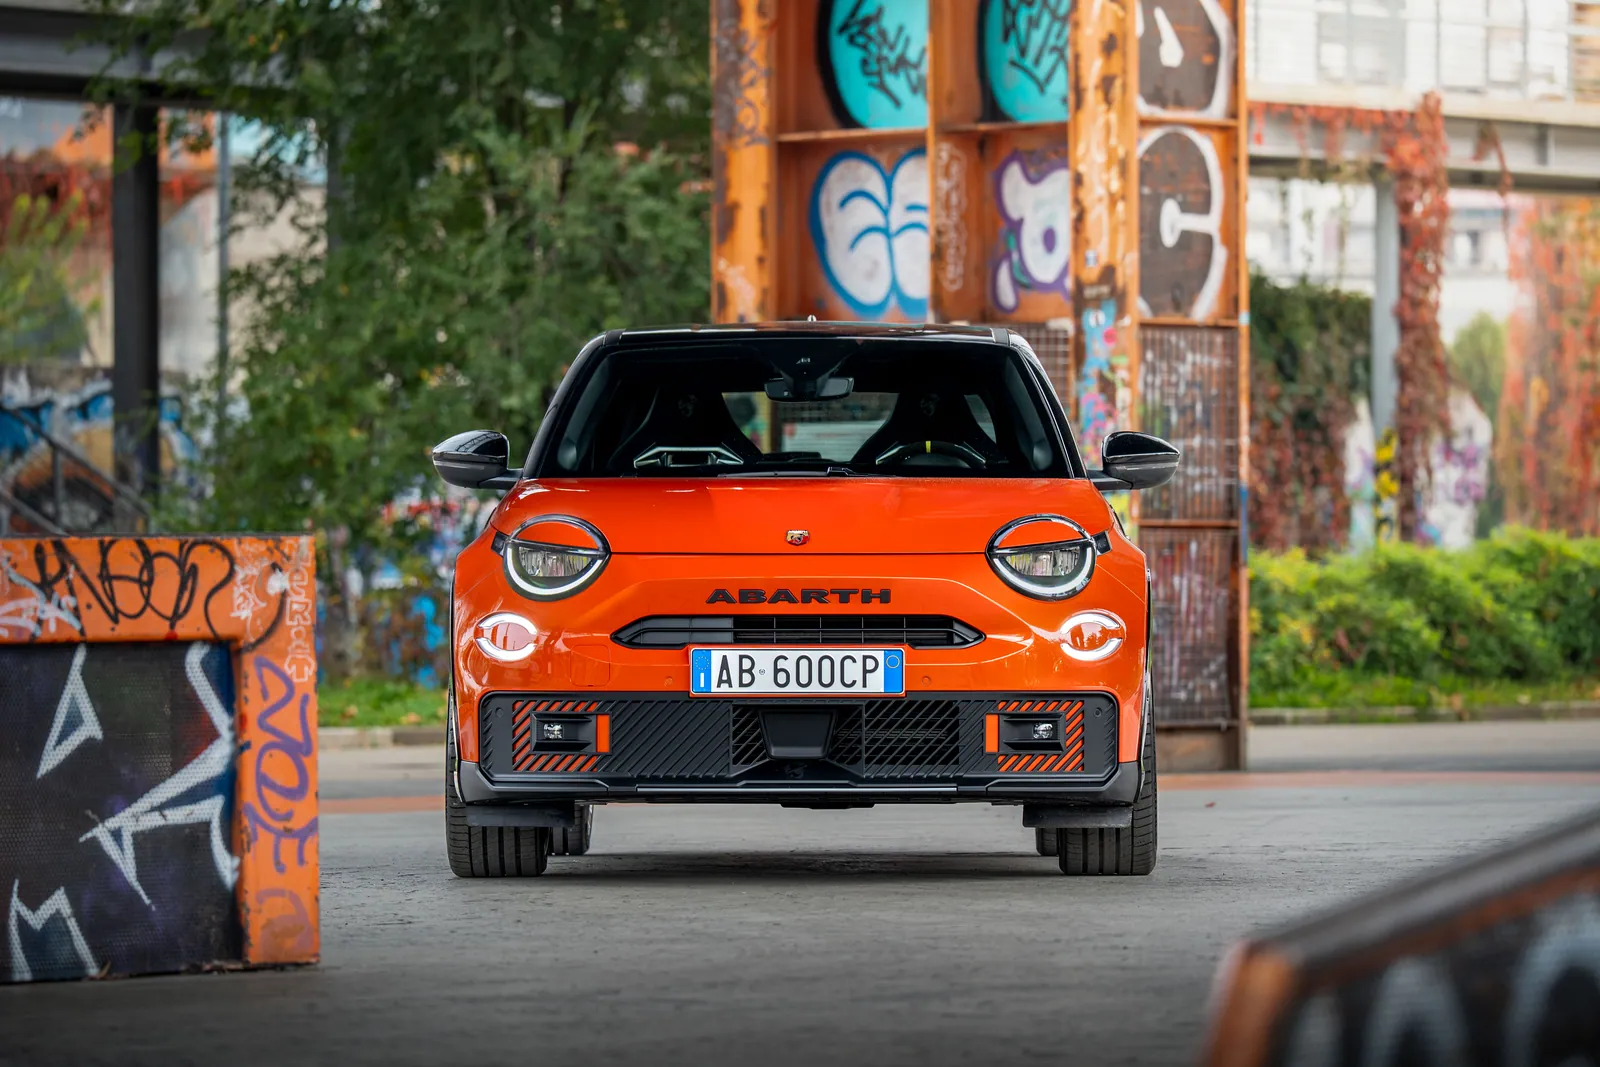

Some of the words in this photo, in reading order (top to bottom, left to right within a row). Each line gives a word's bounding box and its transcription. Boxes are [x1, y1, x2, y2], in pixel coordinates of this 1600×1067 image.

[705, 589, 891, 604] ABARTH
[716, 654, 756, 688] AB
[773, 654, 880, 688] 600CP
